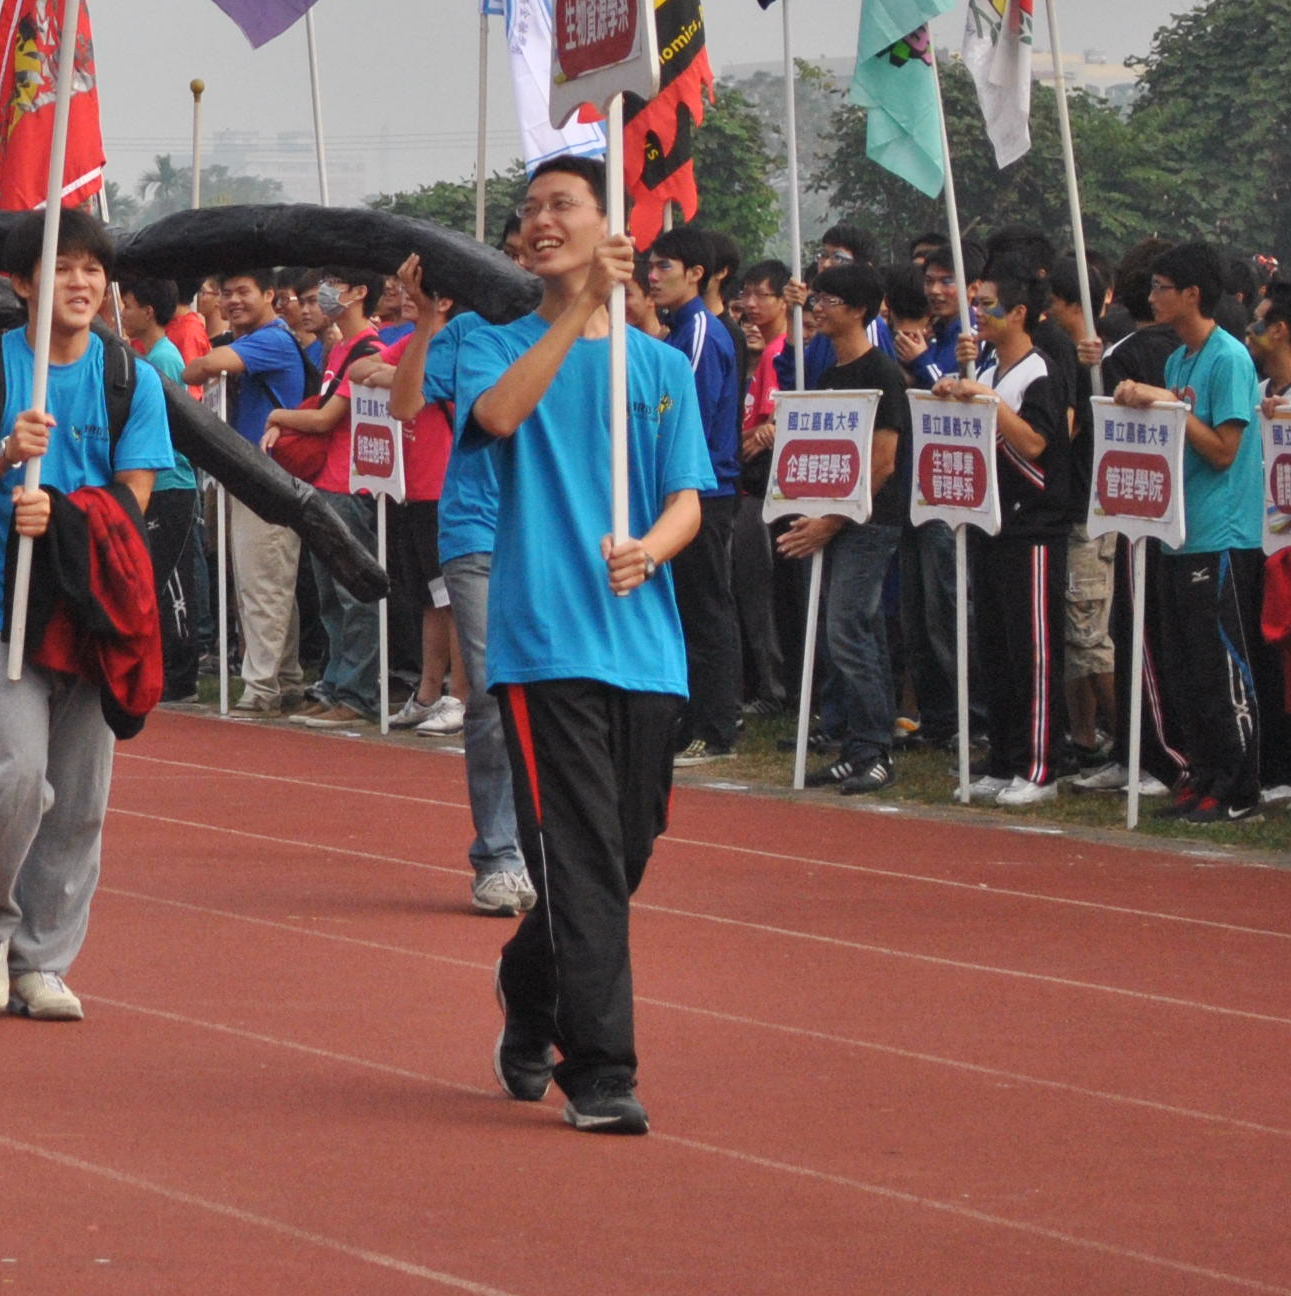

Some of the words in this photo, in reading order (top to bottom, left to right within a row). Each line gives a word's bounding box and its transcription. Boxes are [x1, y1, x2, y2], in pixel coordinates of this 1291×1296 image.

[787, 411, 859, 432] 國立嘉義大學
[922, 413, 982, 439] 國立嘉義大學
[1104, 419, 1169, 447] 國立嘉義大學
[785, 453, 852, 484] 企業管理學系
[932, 449, 974, 478] 生物事業
[932, 474, 975, 502] 管理學系
[1106, 465, 1164, 503] 管理學院
